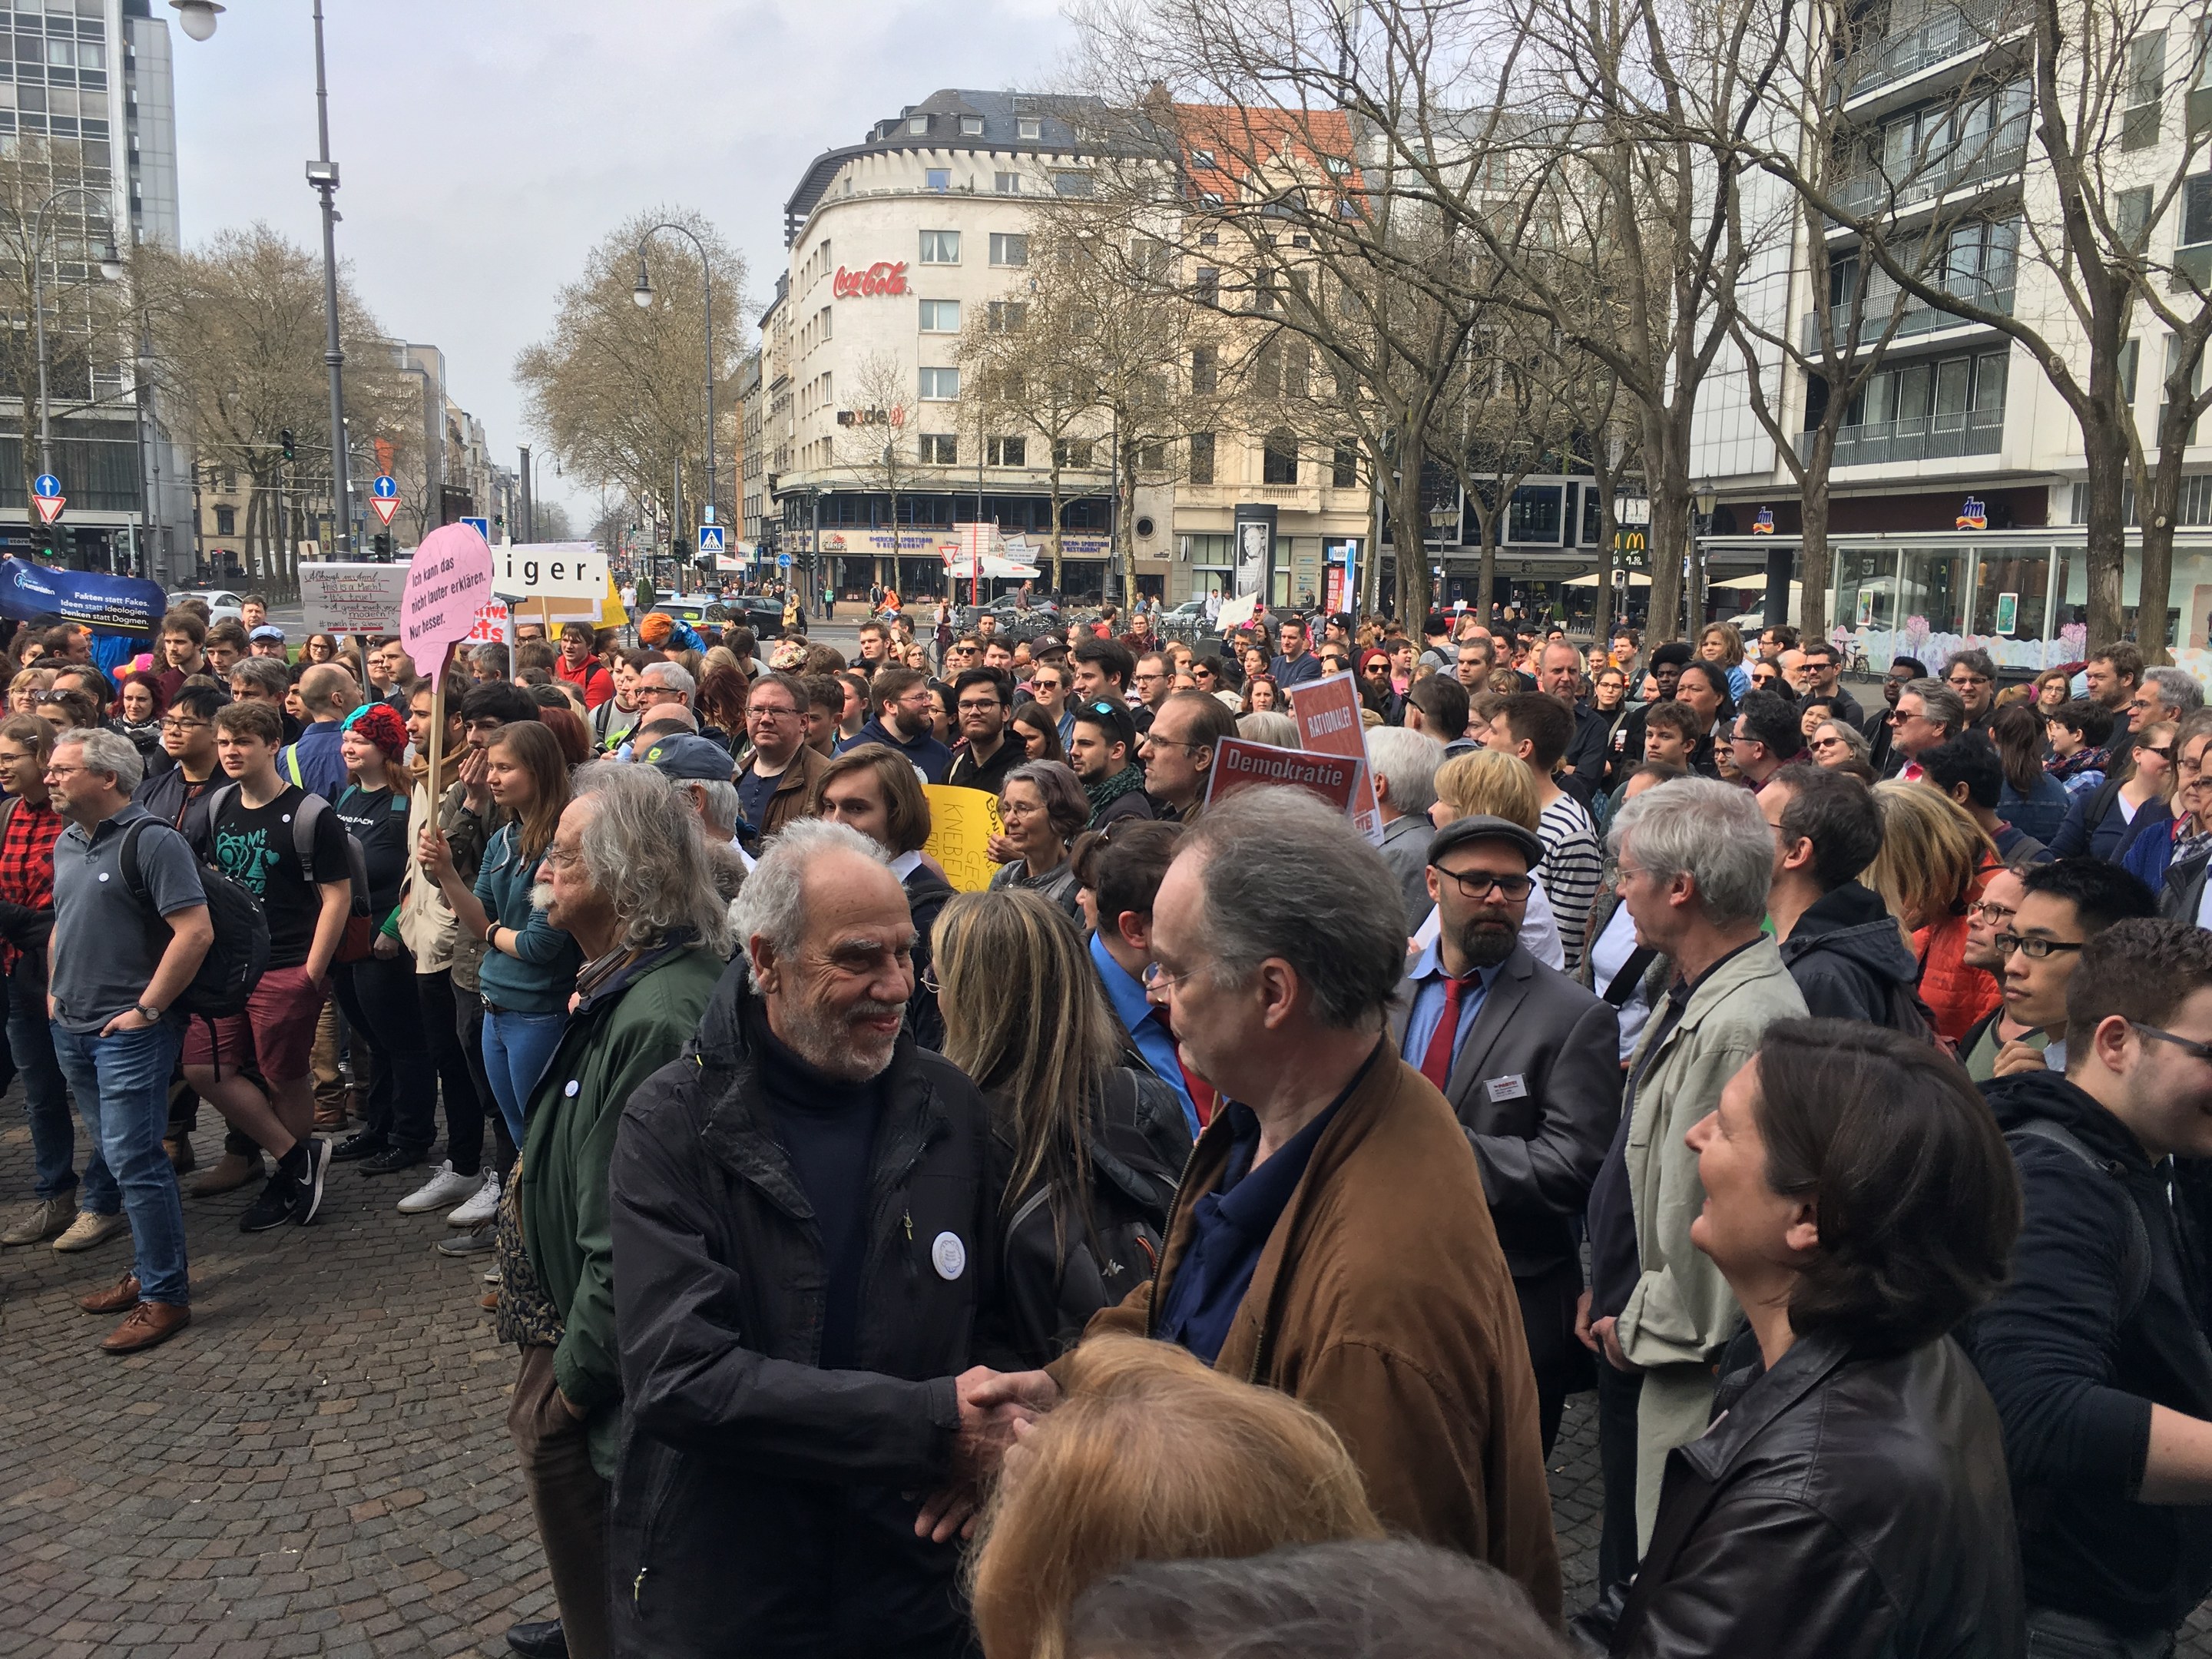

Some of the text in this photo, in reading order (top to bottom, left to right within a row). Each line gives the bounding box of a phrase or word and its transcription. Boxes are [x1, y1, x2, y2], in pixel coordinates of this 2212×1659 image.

[1757, 506, 1772, 524] dm
[1962, 497, 1985, 517] dm
[305, 570, 339, 583] Although
[412, 557, 455, 588] Ich kann das
[492, 553, 601, 585] iger.
[23, 581, 55, 595] Humanisten
[412, 571, 486, 614] nicht lauter erklären.
[61, 599, 84, 609] Ideen
[104, 605, 150, 618] Ideologien.
[75, 592, 150, 607] Fakten statt Fakes.
[341, 604, 359, 614] great
[61, 608, 91, 619] Denken
[112, 614, 149, 626] Dogmen.
[409, 624, 421, 641] Nur
[422, 613, 445, 634] besser.
[469, 619, 504, 644] cts
[1307, 705, 1353, 738] RATIONALER
[1227, 748, 1343, 786] Demokratie
[965, 850, 982, 892] GEG
